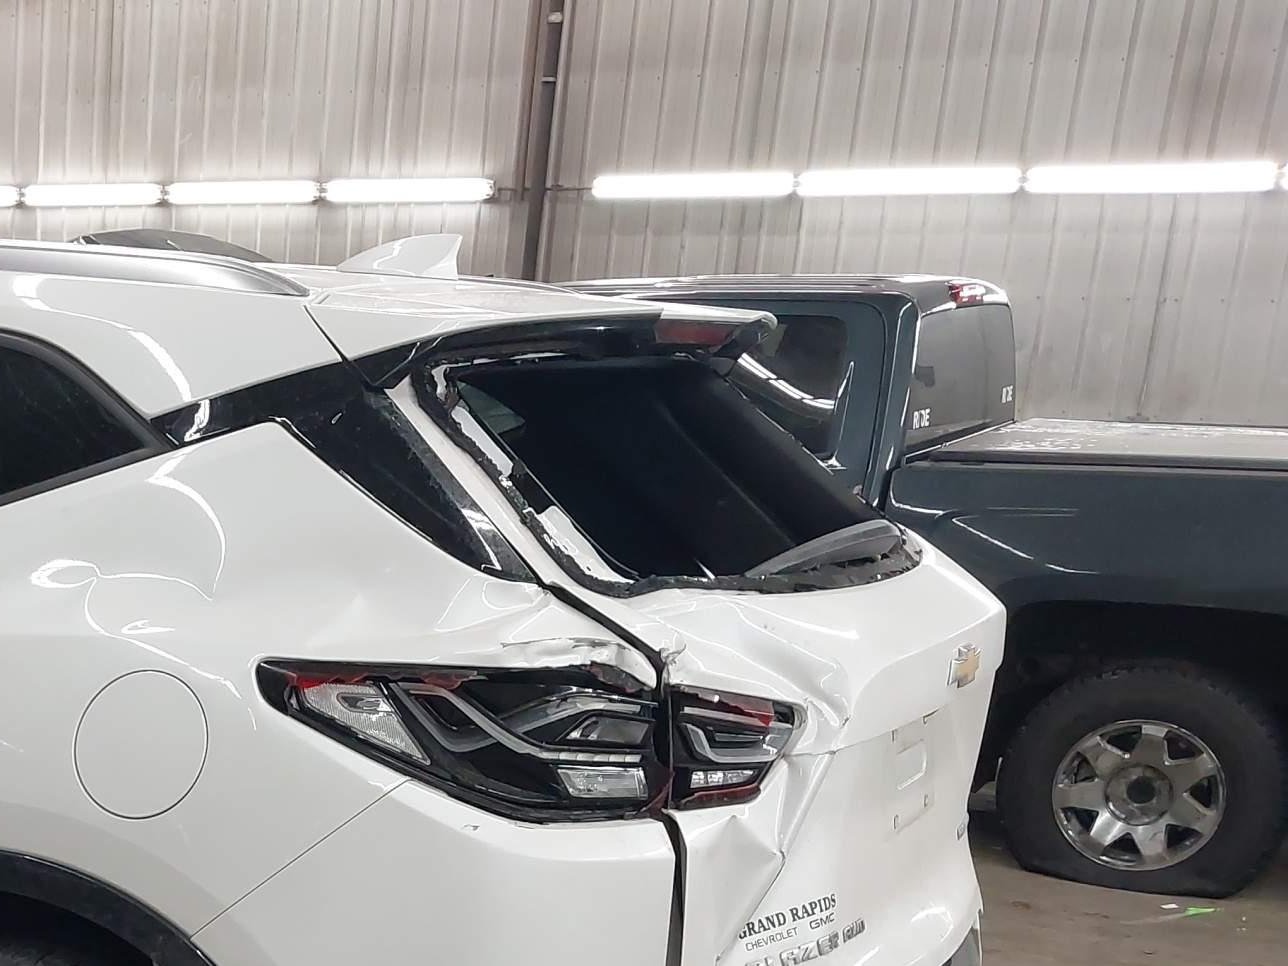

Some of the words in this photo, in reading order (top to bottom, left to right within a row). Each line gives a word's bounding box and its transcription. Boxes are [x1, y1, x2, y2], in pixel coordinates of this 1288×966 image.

[738, 911, 787, 940] GRAND
[789, 893, 836, 922] RAPIDS
[809, 911, 835, 930] GMC
[745, 926, 799, 952] CHEVROLET
